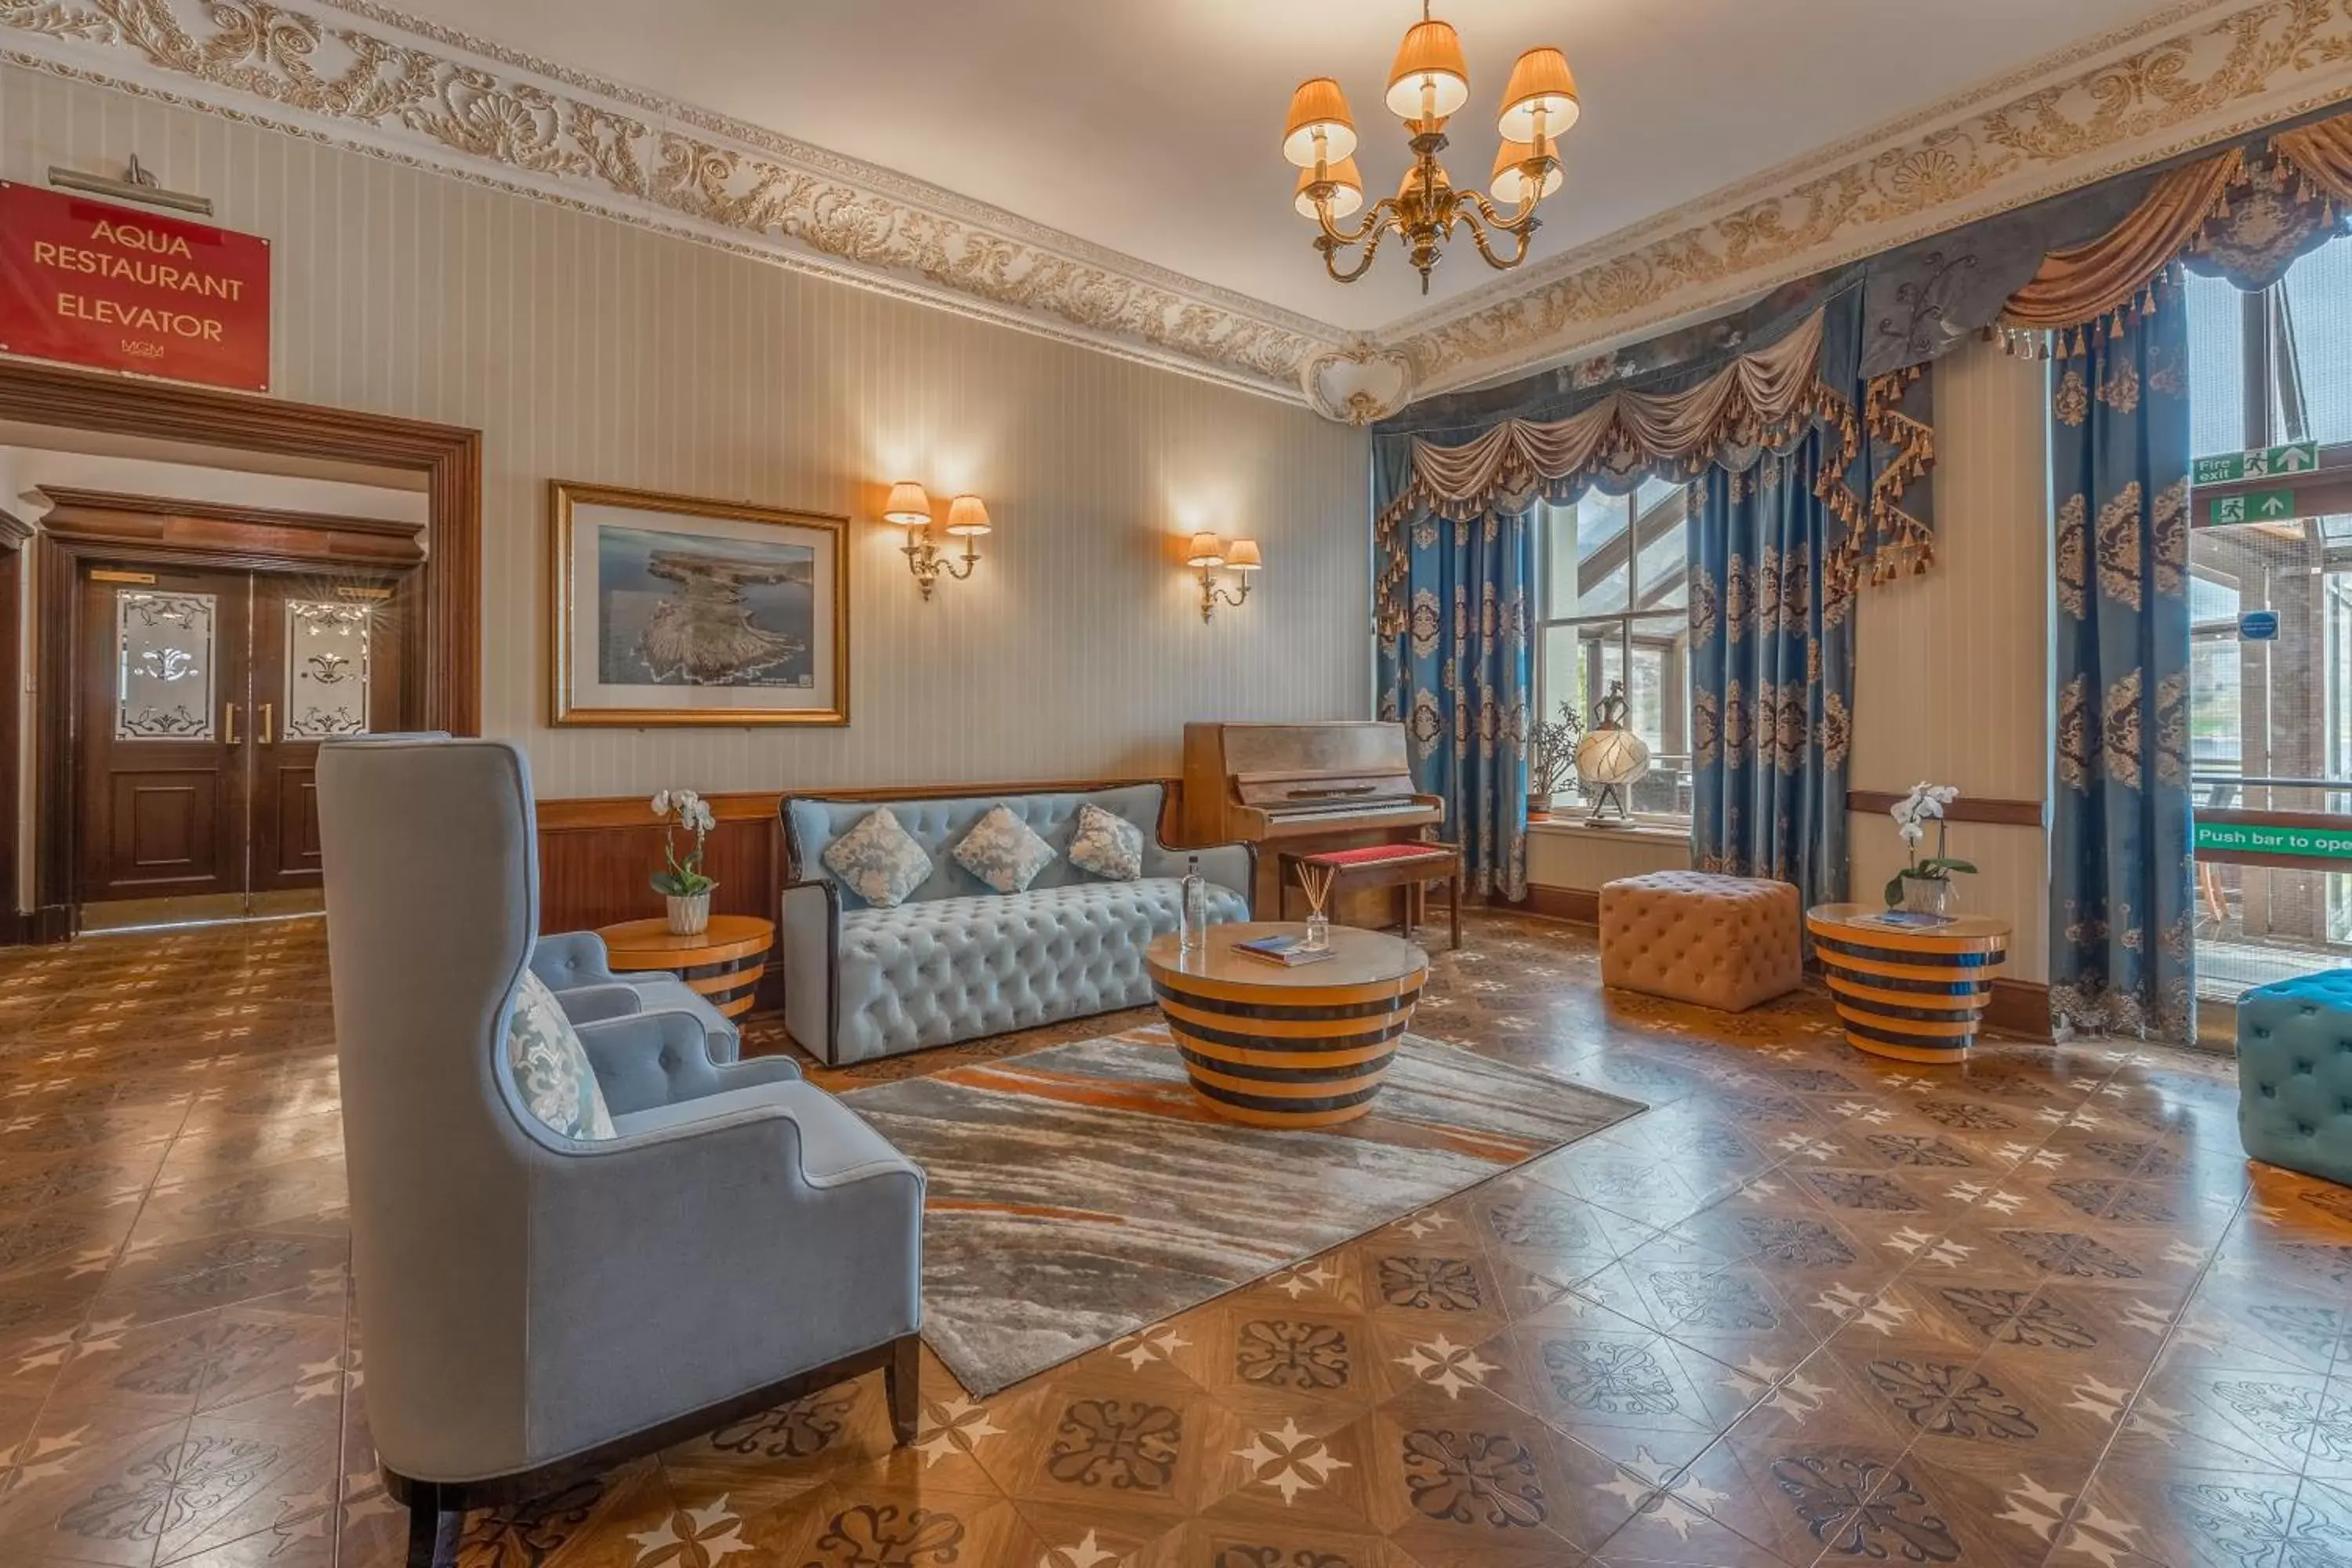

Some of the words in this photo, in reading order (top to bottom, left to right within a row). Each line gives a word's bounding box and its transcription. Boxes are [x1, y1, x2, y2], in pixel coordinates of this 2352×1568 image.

[91, 220, 192, 260] AQUA
[34, 241, 243, 302] RESTAURANT
[57, 292, 223, 343] ELEVATOR
[2198, 459, 2231, 471] Fire
[2198, 469, 2230, 482] exit
[2198, 829, 2246, 844] Push
[2252, 832, 2284, 846] bar
[2288, 836, 2309, 848] to
